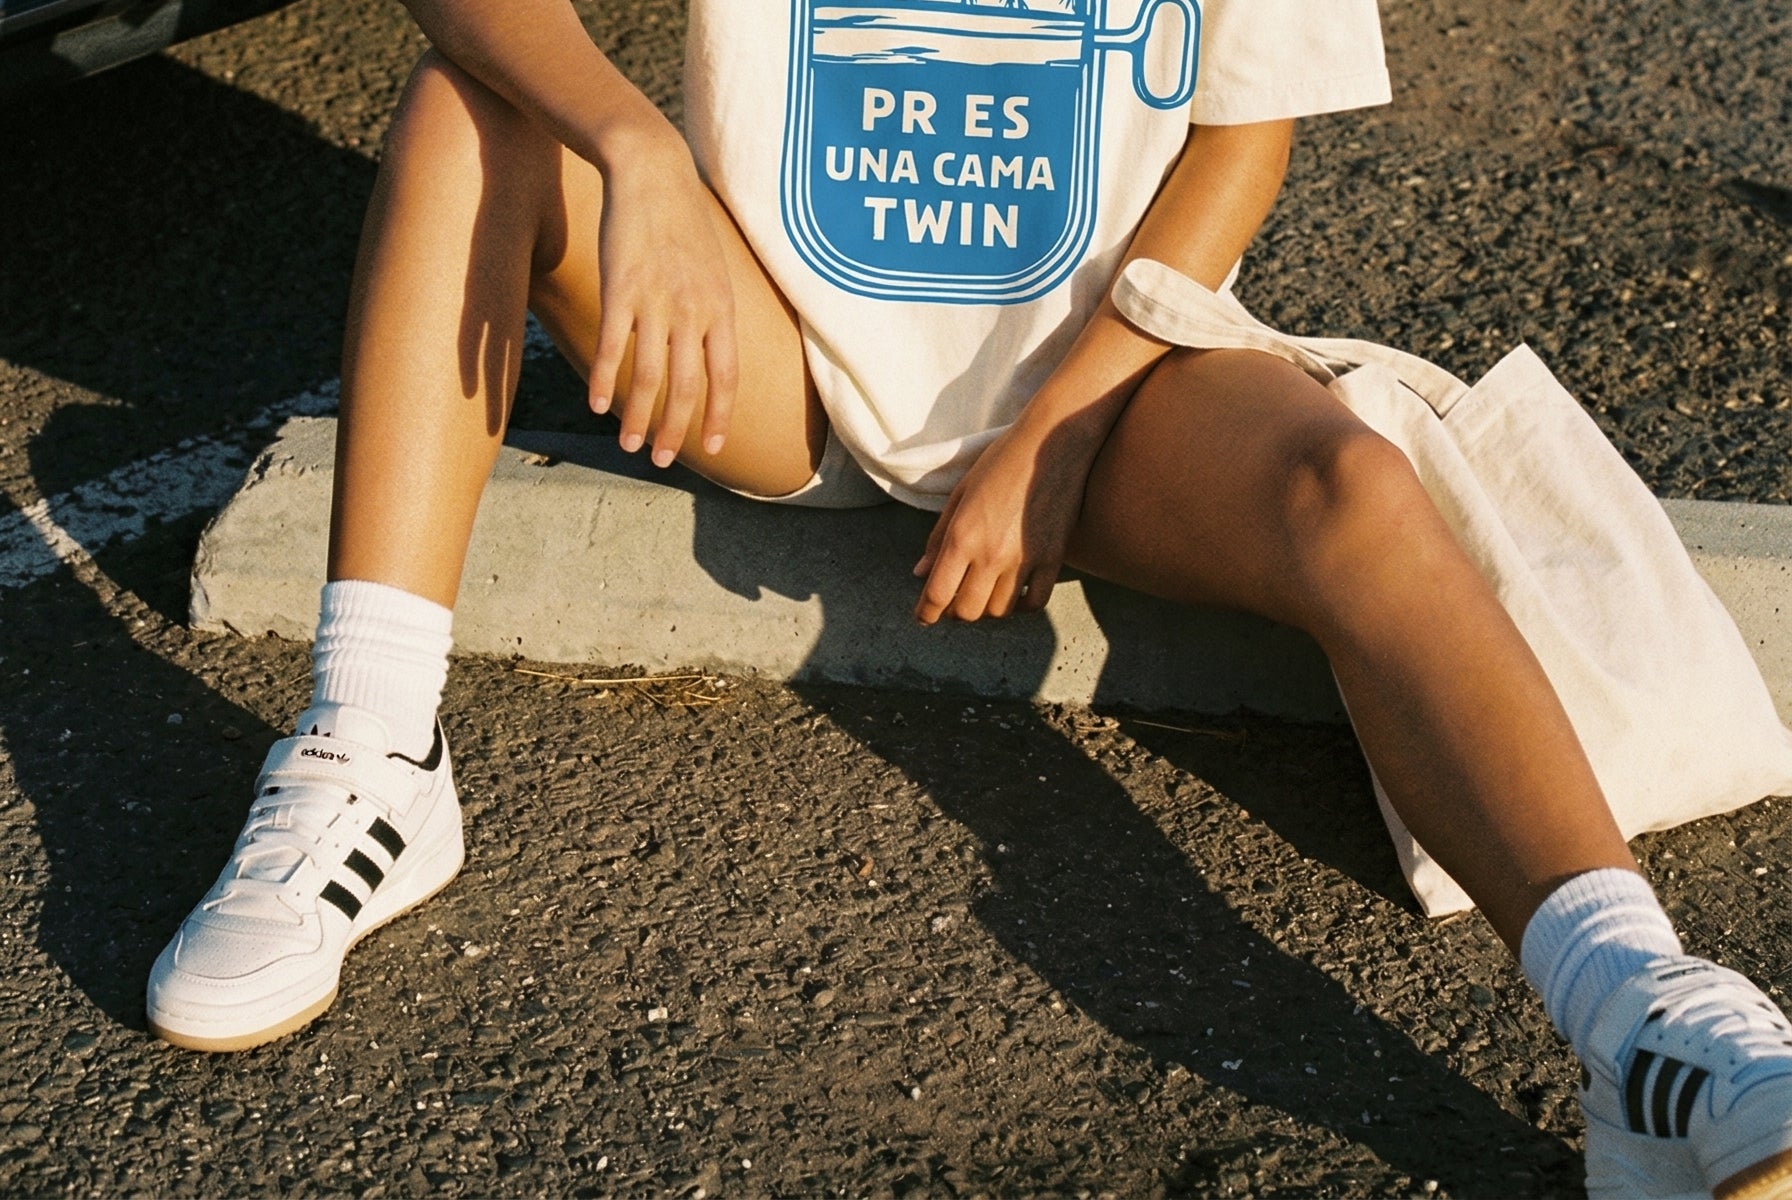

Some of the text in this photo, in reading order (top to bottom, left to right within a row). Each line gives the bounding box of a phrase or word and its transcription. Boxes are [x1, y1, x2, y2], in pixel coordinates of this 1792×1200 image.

[862, 87, 1030, 139] PR ES
[825, 146, 1055, 191] UNA CAMA
[864, 196, 1018, 249] TWIN
